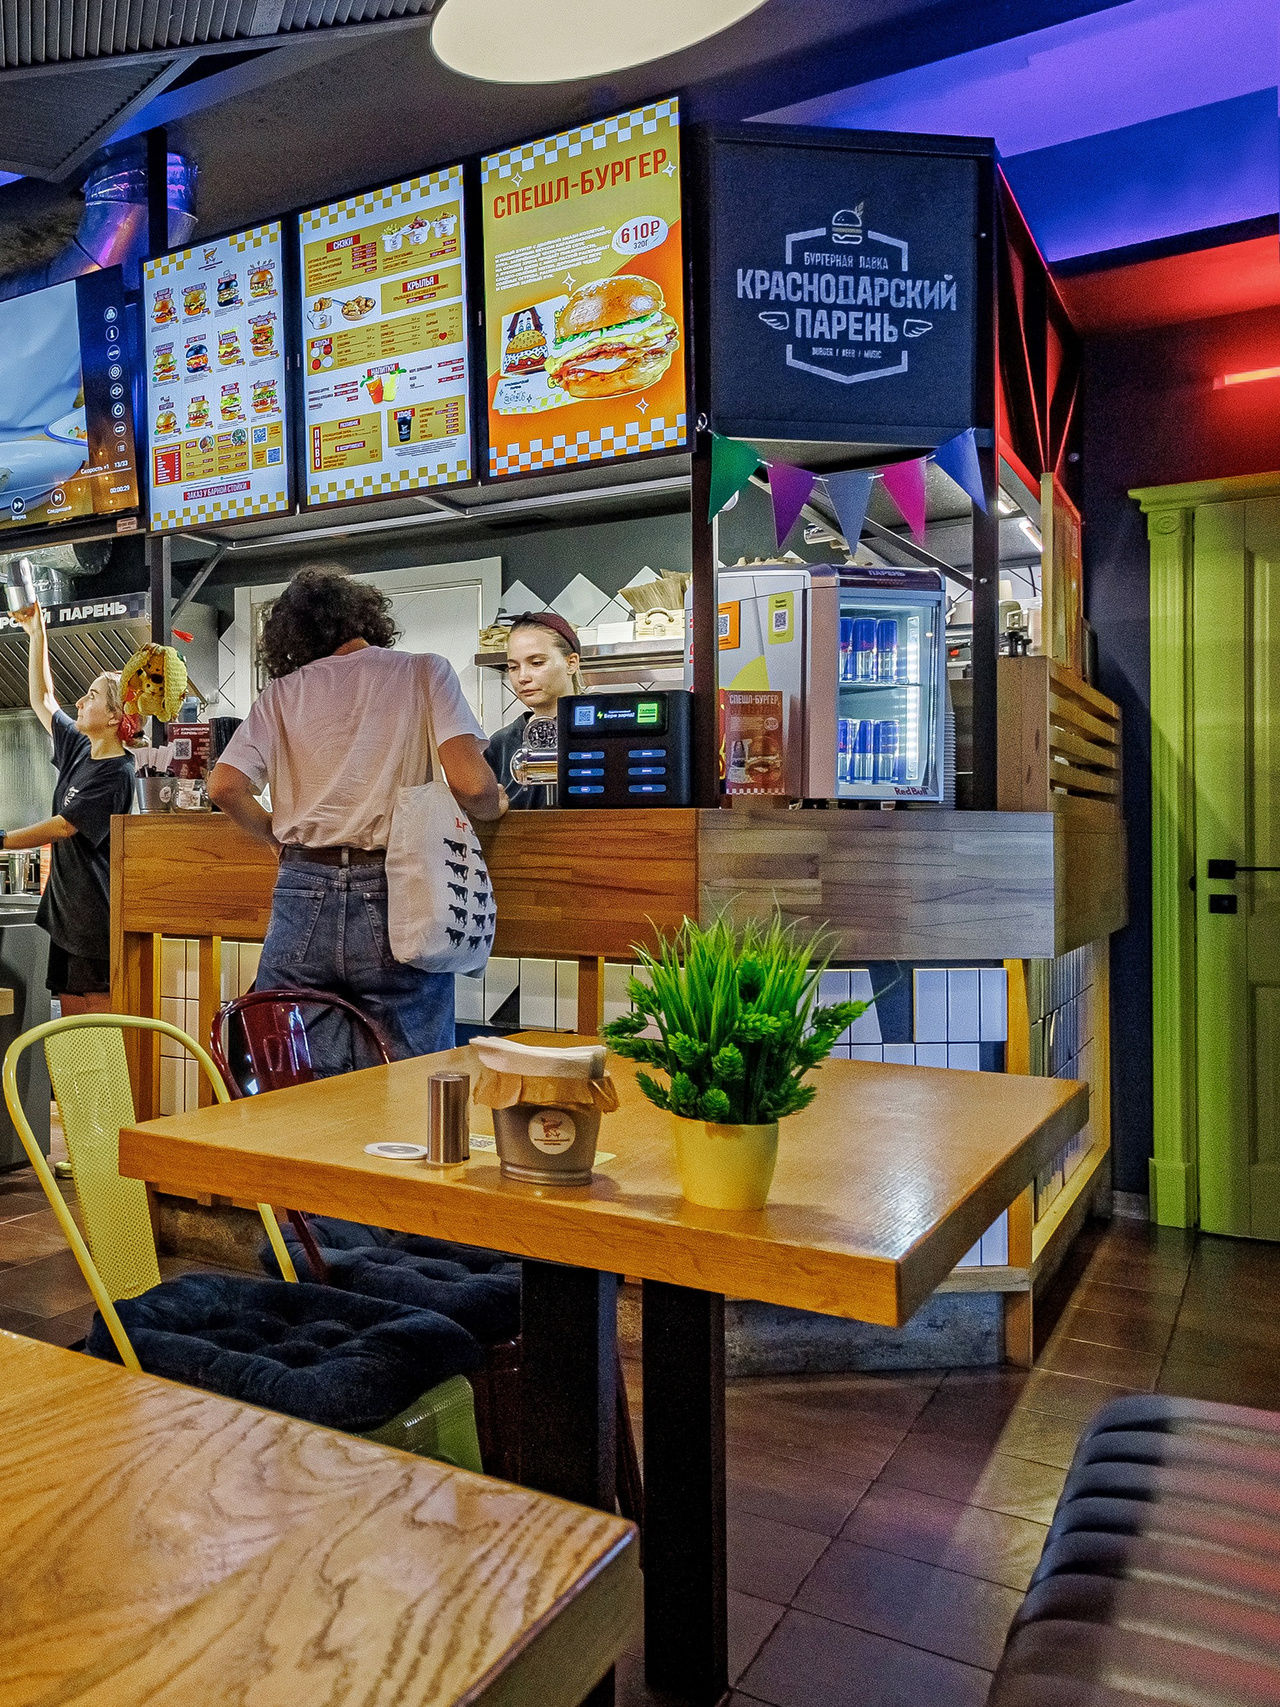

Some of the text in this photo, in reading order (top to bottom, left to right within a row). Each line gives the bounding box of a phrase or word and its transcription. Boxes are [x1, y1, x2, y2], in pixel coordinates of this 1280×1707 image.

[493, 148, 667, 219] СПЕШЛ-БУРГЕР
[333, 236, 354, 251] СНЭКИ
[804, 251, 889, 270] БУРГЕРНАЯ ЛАВКА
[406, 275, 434, 291] КРЫЛЬЯ
[736, 268, 957, 311] КРАСНОДАРСКИЙ
[795, 308, 899, 343] ПАРЕНЬ
[313, 428, 322, 469] ПИВО
[868, 569, 906, 577] ПАРЕНЬ
[59, 601, 128, 622] ПАРЕНЬ
[730, 694, 779, 705] СПЕШЛ-БУРГЕР
